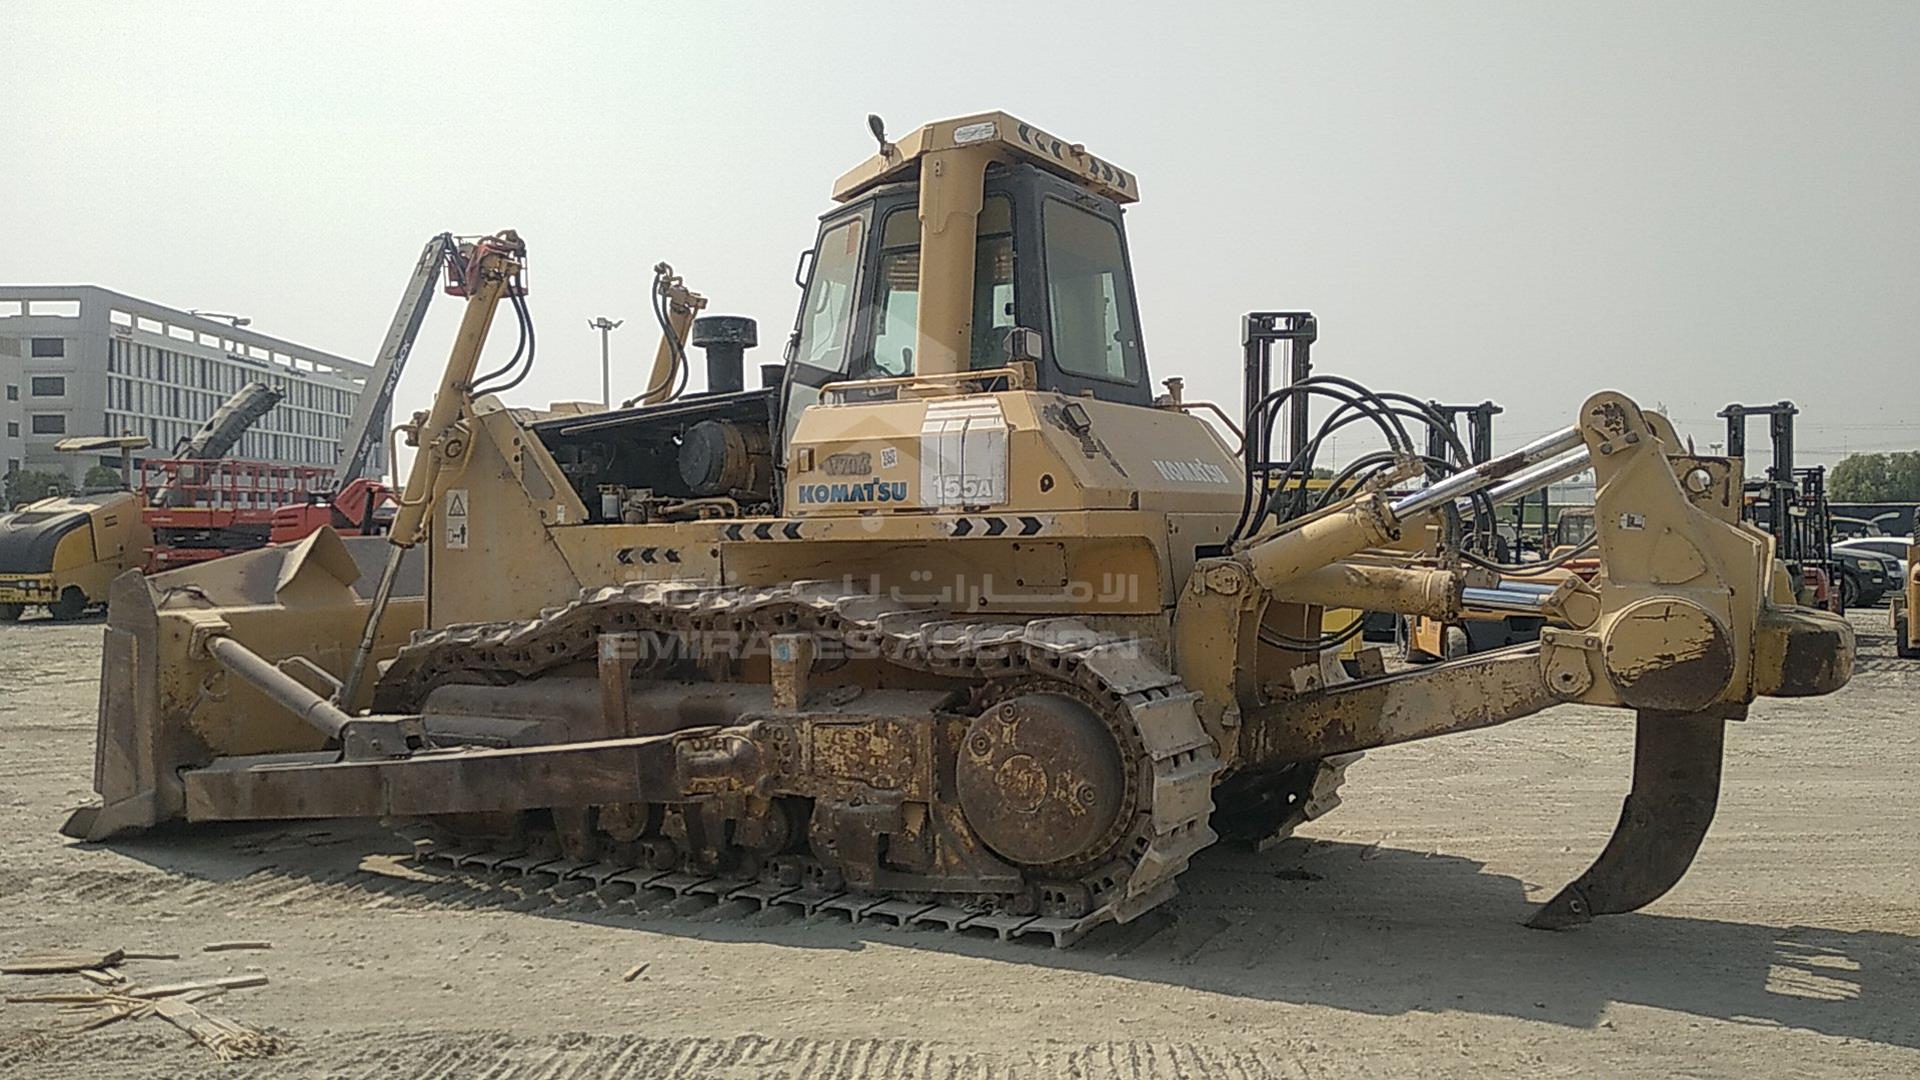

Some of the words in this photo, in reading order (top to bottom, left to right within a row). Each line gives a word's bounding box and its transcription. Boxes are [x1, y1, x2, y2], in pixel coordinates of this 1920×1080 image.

[384, 340, 410, 397] SKYJACK
[1151, 458, 1229, 484] KOMATSU
[798, 477, 908, 504] KOMATSU
[932, 474, 993, 498] 155A
